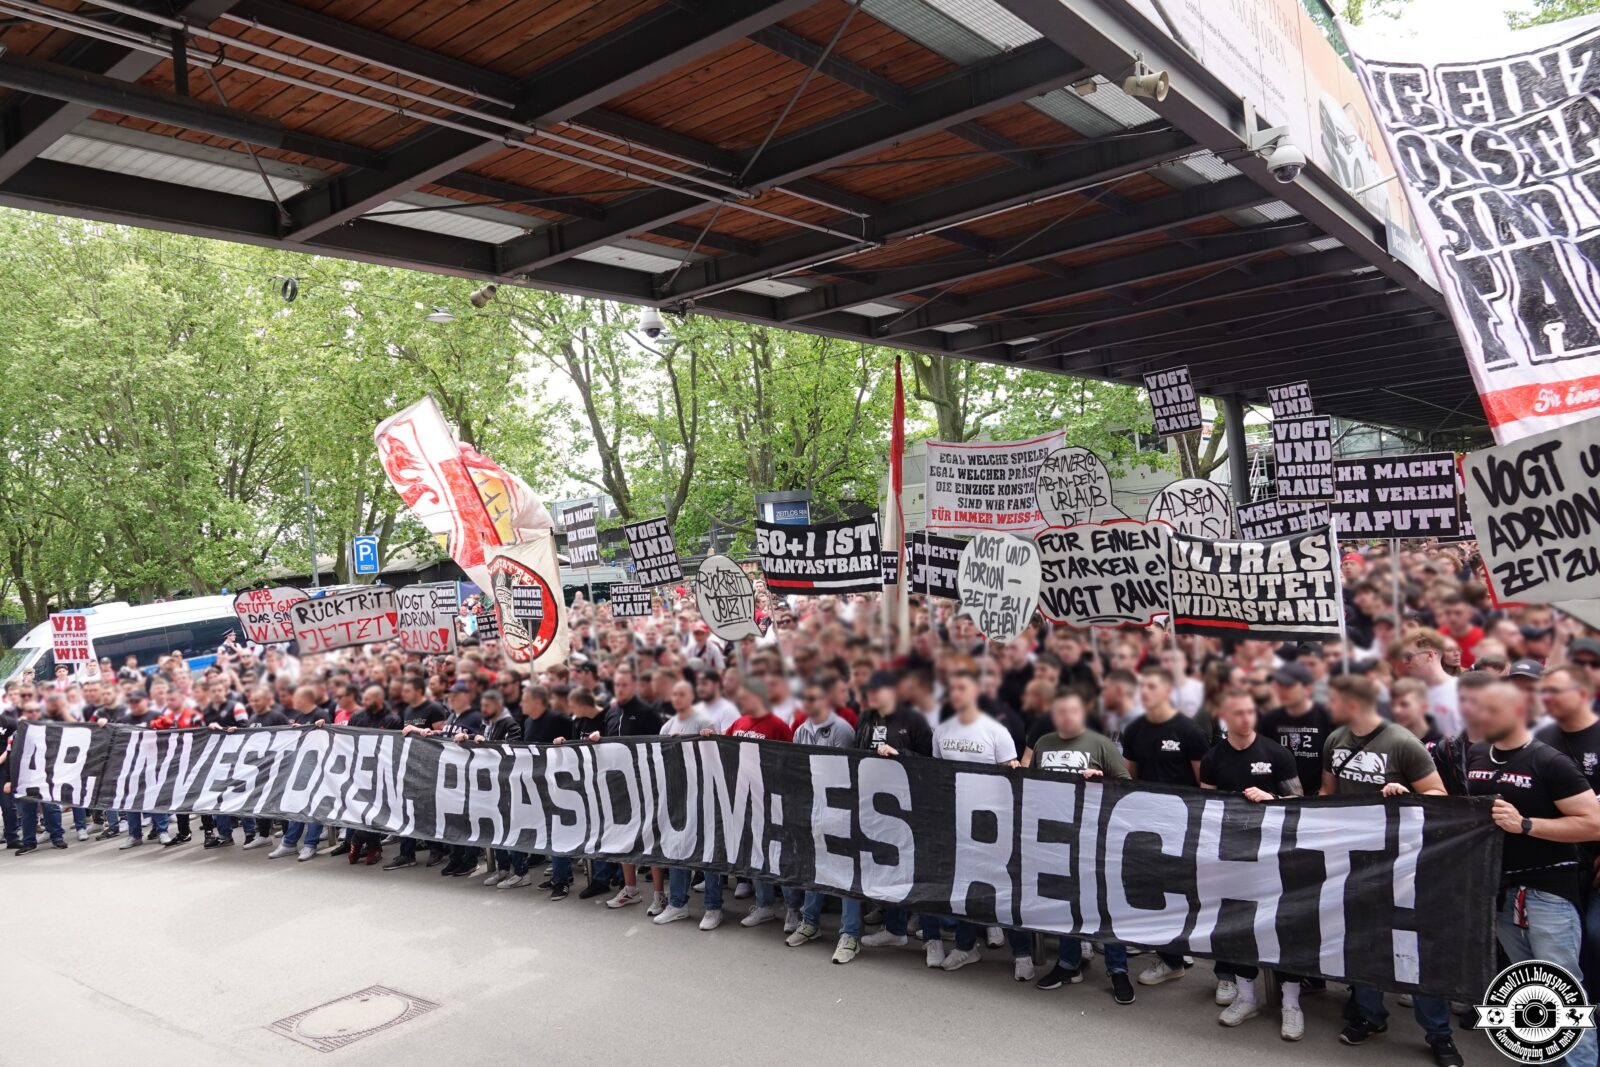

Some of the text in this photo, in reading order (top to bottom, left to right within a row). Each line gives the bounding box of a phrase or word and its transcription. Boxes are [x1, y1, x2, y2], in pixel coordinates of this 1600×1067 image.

[1145, 368, 1188, 390] VOGT
[1149, 383, 1195, 407] UND
[1269, 383, 1308, 401] VOGT
[1154, 401, 1197, 418] ADRION
[1271, 396, 1313, 416] UND
[1157, 412, 1201, 432] RAUS
[1273, 419, 1330, 441] VOGT
[940, 447, 1049, 466] EGAL WELCHE SPIELER
[1275, 440, 1332, 464] UND
[930, 465, 955, 479] EGAL
[957, 467, 1006, 481] WELCHER
[1277, 462, 1332, 478] ADRION
[1373, 459, 1454, 480] MACHT
[1471, 439, 1566, 509] VOGT
[936, 481, 952, 493] DIE
[955, 483, 995, 496] EINZIGE
[1278, 477, 1334, 497] RAUS
[1375, 484, 1454, 503] VEREIN
[957, 496, 1035, 511] SIND WIR FANS!
[931, 506, 953, 522] FÜR
[954, 510, 994, 524] IMMER
[1331, 507, 1456, 533] KAPUTT
[1487, 486, 1600, 558] ADRION
[626, 519, 667, 541] VOGT
[756, 523, 877, 557] 50+1 IST
[1038, 526, 1162, 555] FÜR EINEN
[1241, 519, 1284, 541] HALT
[569, 543, 598, 564] KAPUTT
[630, 535, 674, 560] UND
[973, 534, 1031, 567] VOGT UND
[1170, 534, 1330, 574] ULTRAS
[636, 553, 677, 571] ADRION
[1040, 555, 1140, 583] STARKEN
[1492, 548, 1562, 598] ZEIT
[638, 564, 682, 585] RAUS
[963, 556, 1005, 591] ADRION
[1171, 569, 1333, 600] BEDEUTET
[396, 593, 425, 611] VOGT
[429, 590, 439, 610] &
[612, 593, 651, 603] HALT DEIN
[612, 601, 652, 616] MAUL
[962, 588, 998, 610] ZEIT
[1039, 584, 1103, 618] VOGT
[1172, 593, 1339, 622] WIDERSTAND
[248, 611, 292, 624] DAS SIN
[298, 612, 398, 651] JETZT!
[400, 627, 450, 653] RAUS!
[54, 647, 90, 660] WIR
[71, 639, 88, 647] SIND
[1302, 734, 1313, 748] 2
[434, 739, 784, 877] PRÄSIDIUM:
[808, 754, 916, 902] ES
[949, 772, 1425, 984] REICHT!
